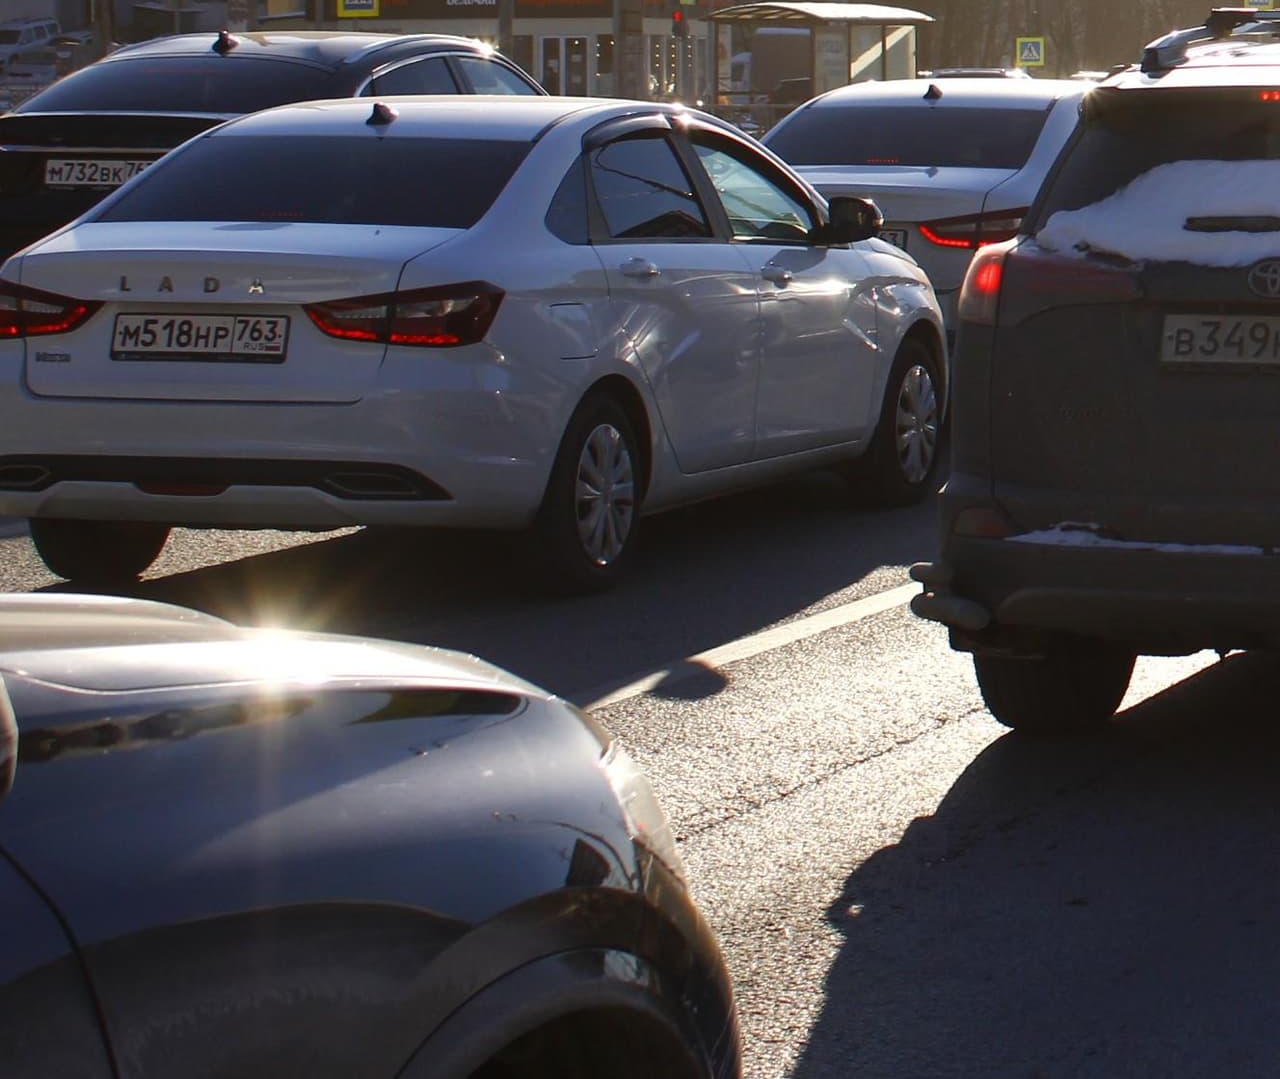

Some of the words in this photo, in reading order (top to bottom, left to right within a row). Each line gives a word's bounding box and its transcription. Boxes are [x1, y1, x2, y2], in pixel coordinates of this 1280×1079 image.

[50, 162, 123, 183] М732ВК
[119, 275, 265, 294] LADA
[120, 319, 230, 348] М518НР
[236, 319, 279, 342] 763
[243, 342, 265, 351] RUS
